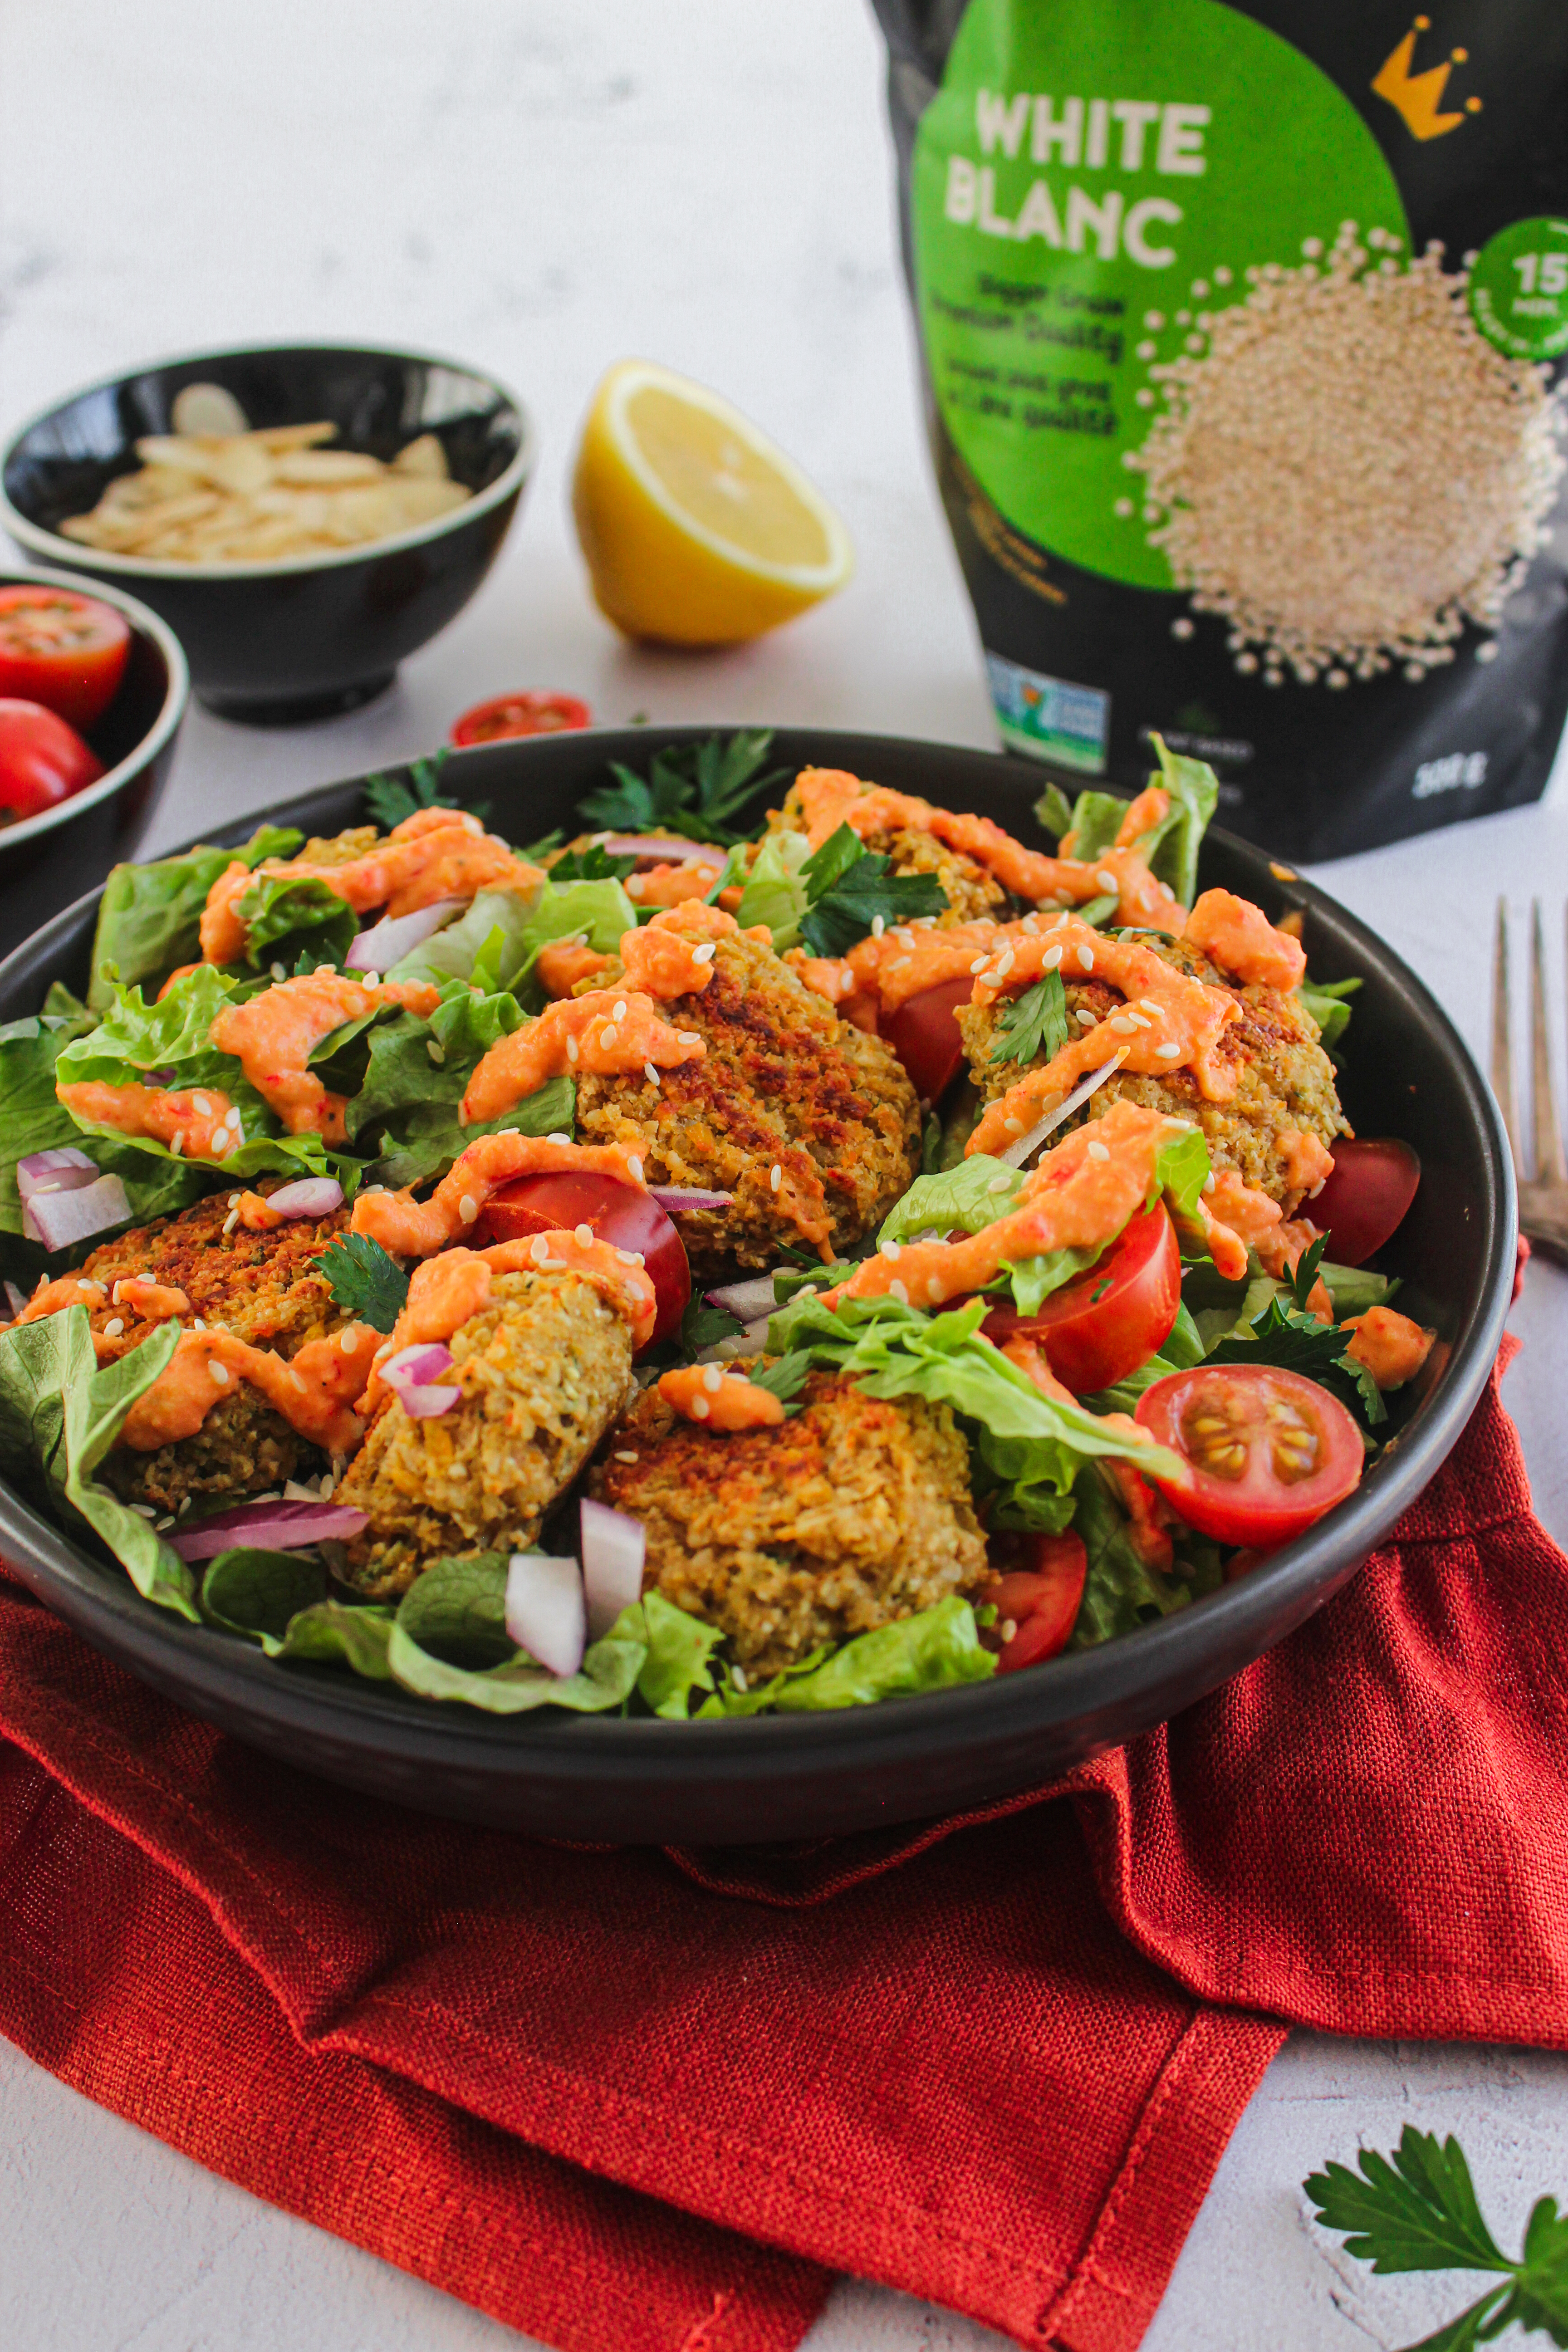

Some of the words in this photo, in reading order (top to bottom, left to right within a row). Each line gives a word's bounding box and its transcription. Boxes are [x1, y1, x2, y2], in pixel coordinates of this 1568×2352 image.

[976, 88, 1211, 176] WHITE
[946, 153, 1182, 269] BLANC
[1513, 252, 1568, 294] 15
